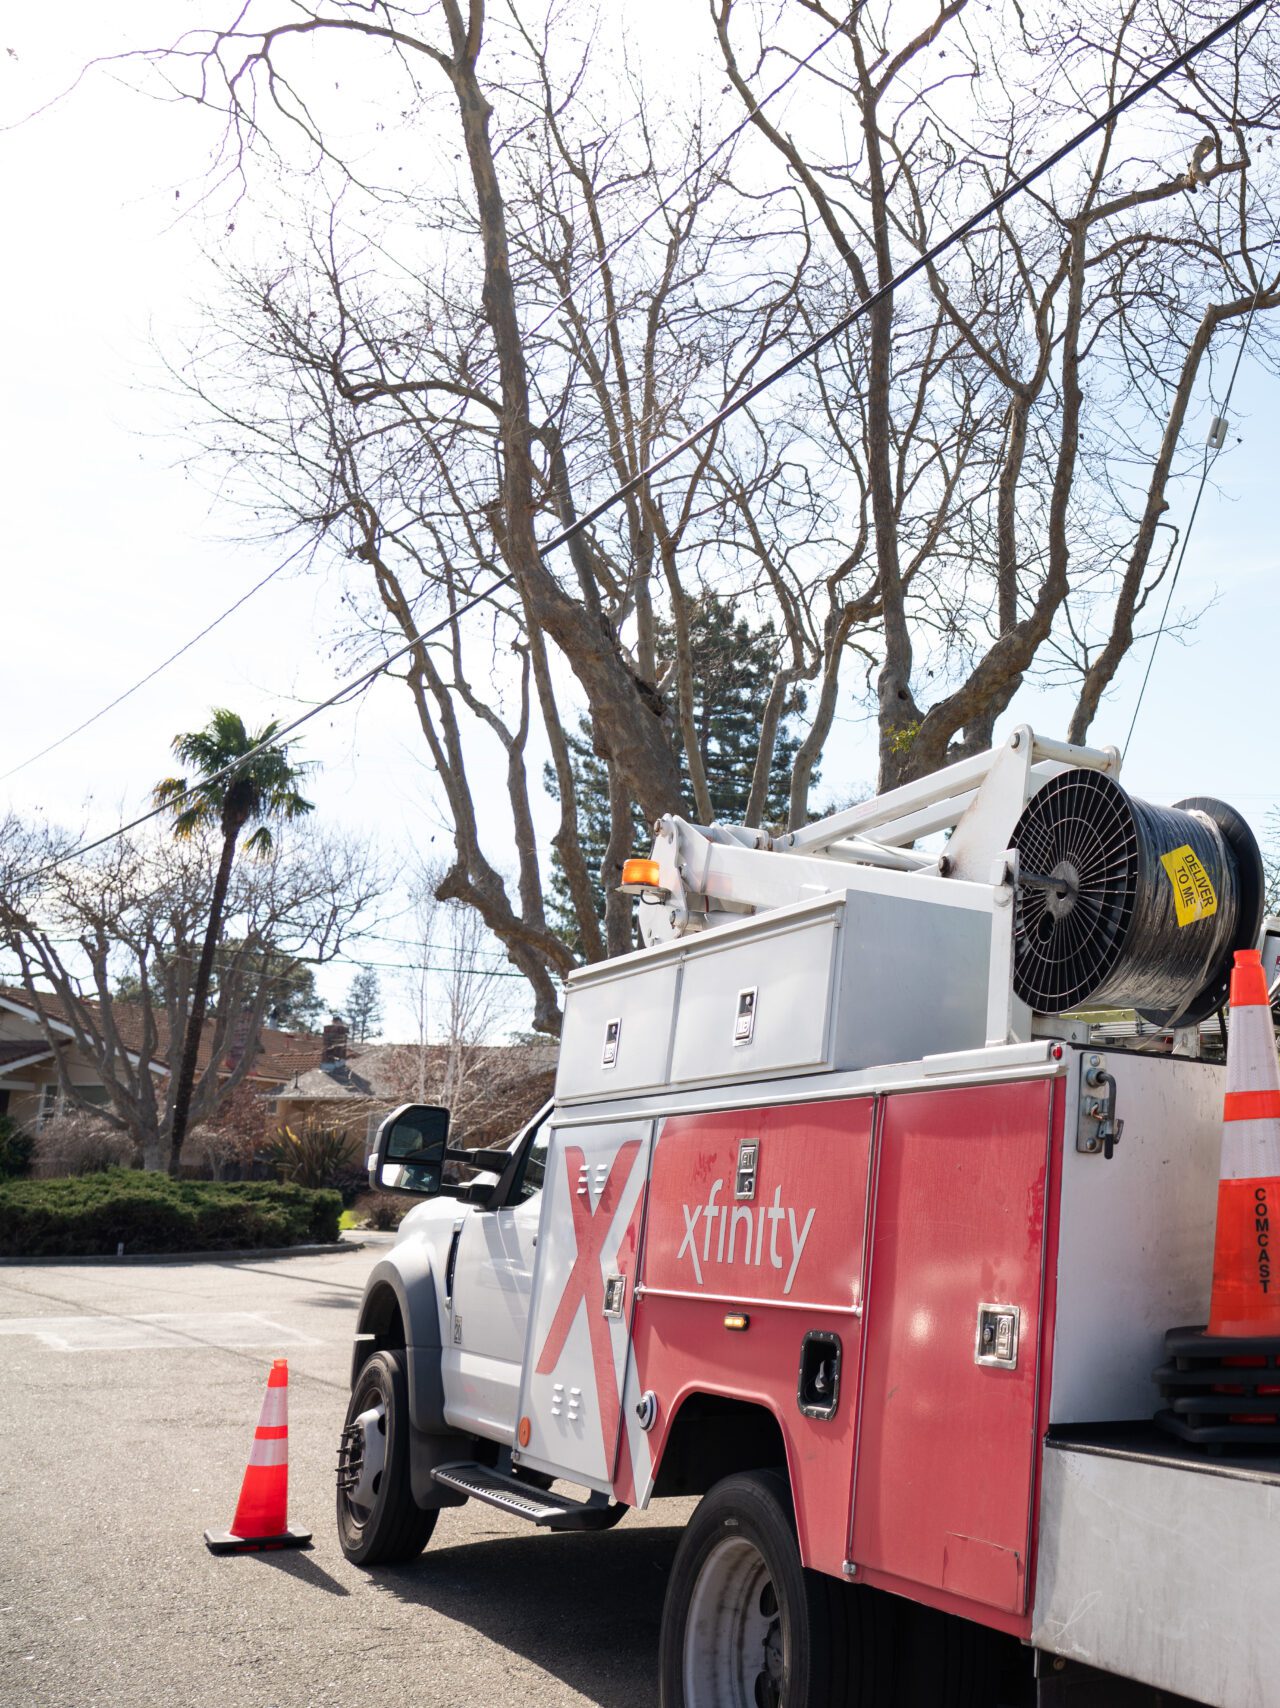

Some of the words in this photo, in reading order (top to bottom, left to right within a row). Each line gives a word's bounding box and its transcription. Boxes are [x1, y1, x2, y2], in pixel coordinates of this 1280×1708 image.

[1177, 866, 1190, 885] TO
[1182, 886, 1196, 908] ME
[1184, 854, 1214, 908] DELIVER
[677, 1178, 817, 1294] xfinity
[1254, 1187, 1271, 1294] COMCAST
